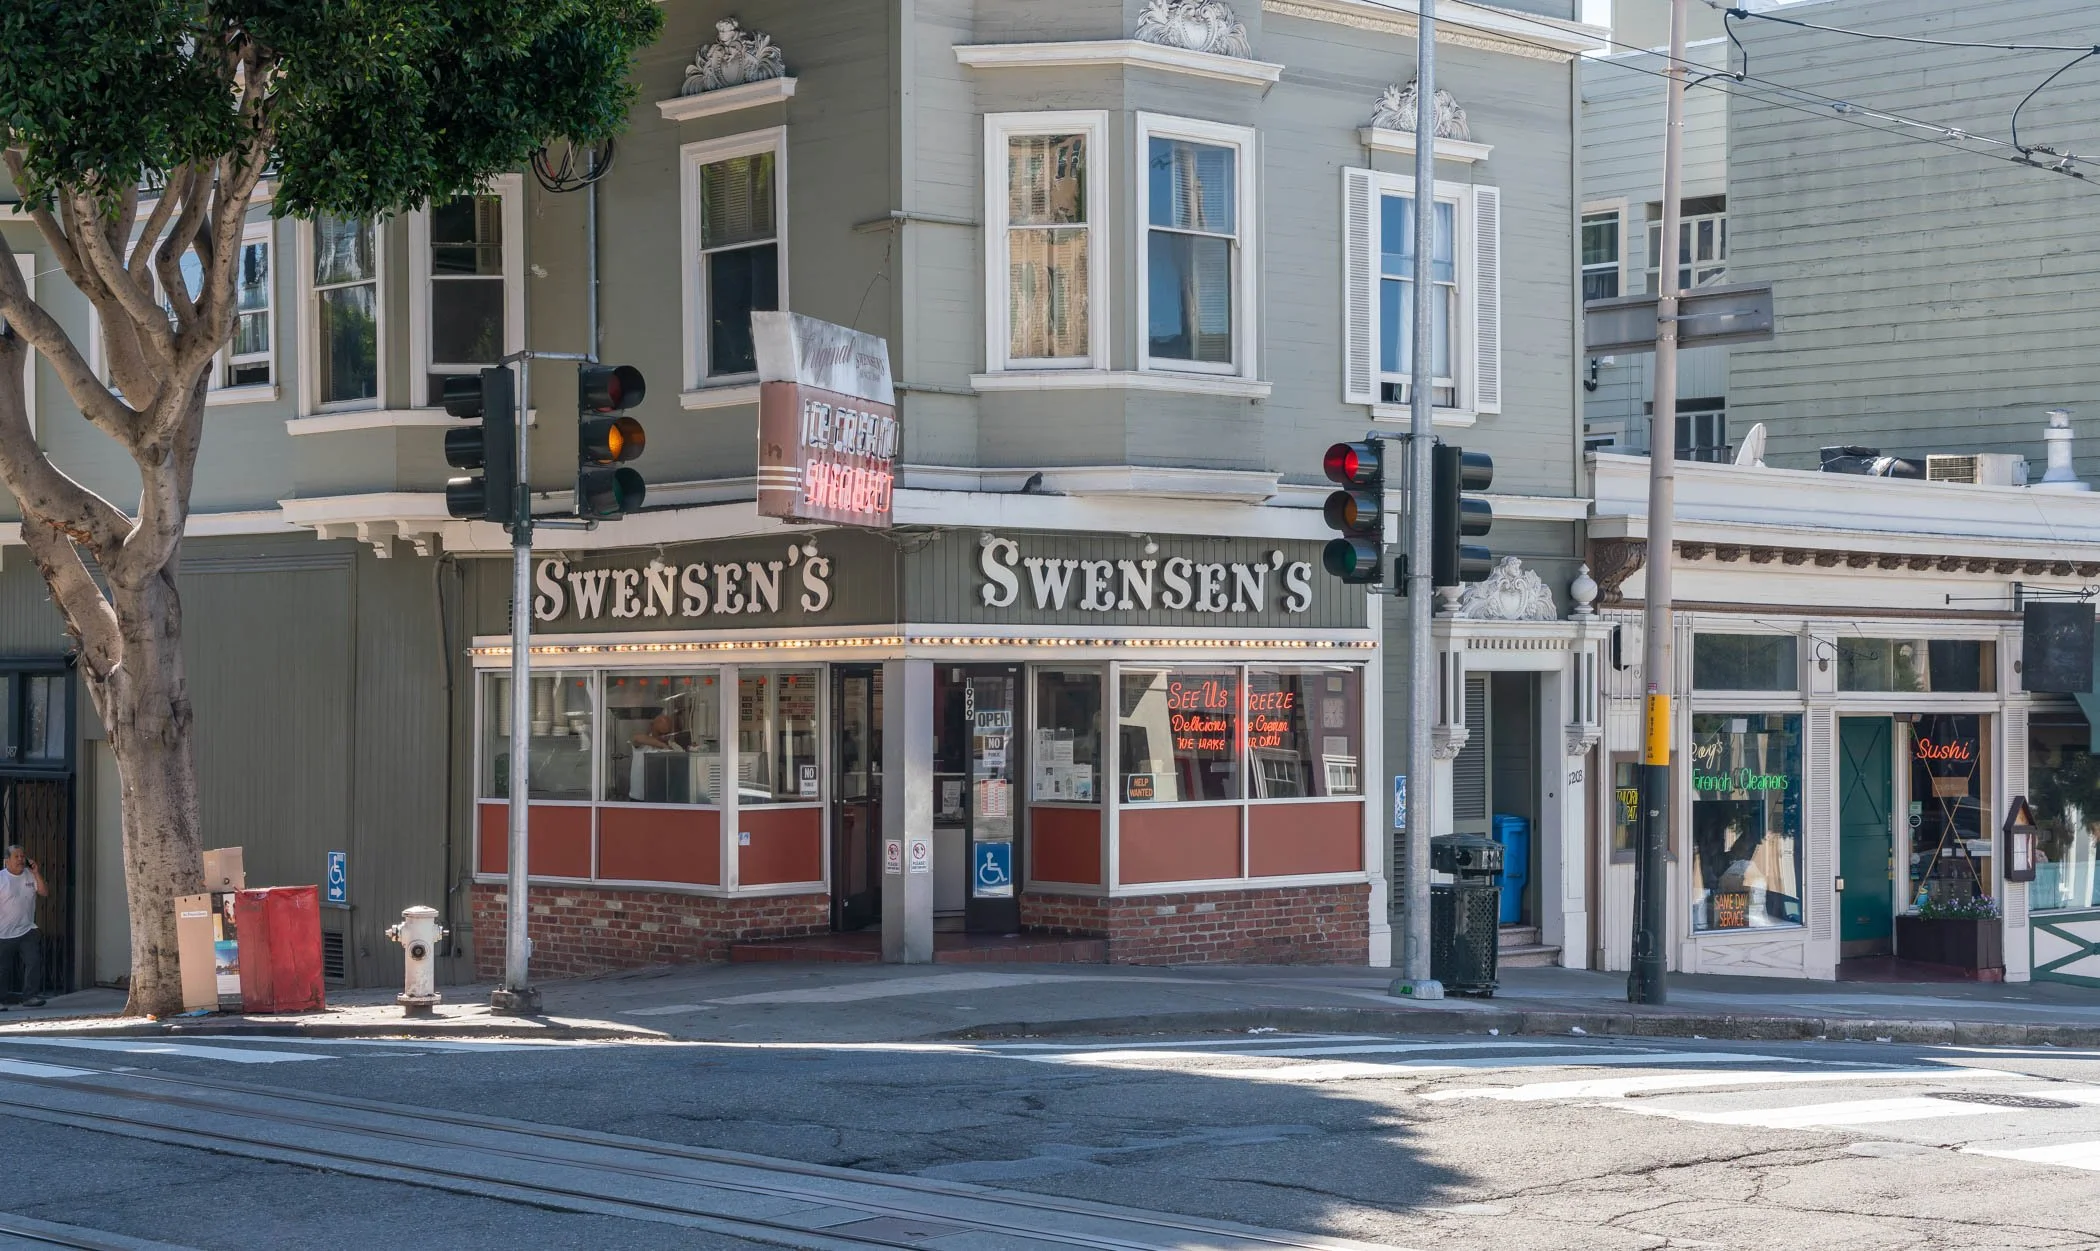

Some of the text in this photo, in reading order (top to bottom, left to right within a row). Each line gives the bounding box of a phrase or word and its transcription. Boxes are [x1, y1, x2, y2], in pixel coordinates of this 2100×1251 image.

[801, 398, 900, 461] ICE CREAM
[534, 545, 831, 621] SWENSEN'S
[980, 537, 1313, 614] SWENSEN'S
[1168, 682, 1201, 709] SEE
[978, 712, 1010, 728] OPEN
[1171, 714, 1227, 732] Delicious
[1256, 714, 1289, 732] Cream
[988, 738, 1001, 749] NO
[1177, 738, 1194, 750] WE
[1198, 738, 1225, 750] MAKE
[1259, 735, 1281, 747] OWN
[1916, 738, 1970, 760] Sushi
[804, 767, 815, 779] NO
[1693, 768, 1790, 793] French Cleaners
[1134, 778, 1149, 787] HELP
[1130, 788, 1153, 798] WANTED
[1714, 894, 1733, 910] SAME
[1719, 911, 1745, 927] SERVICE
